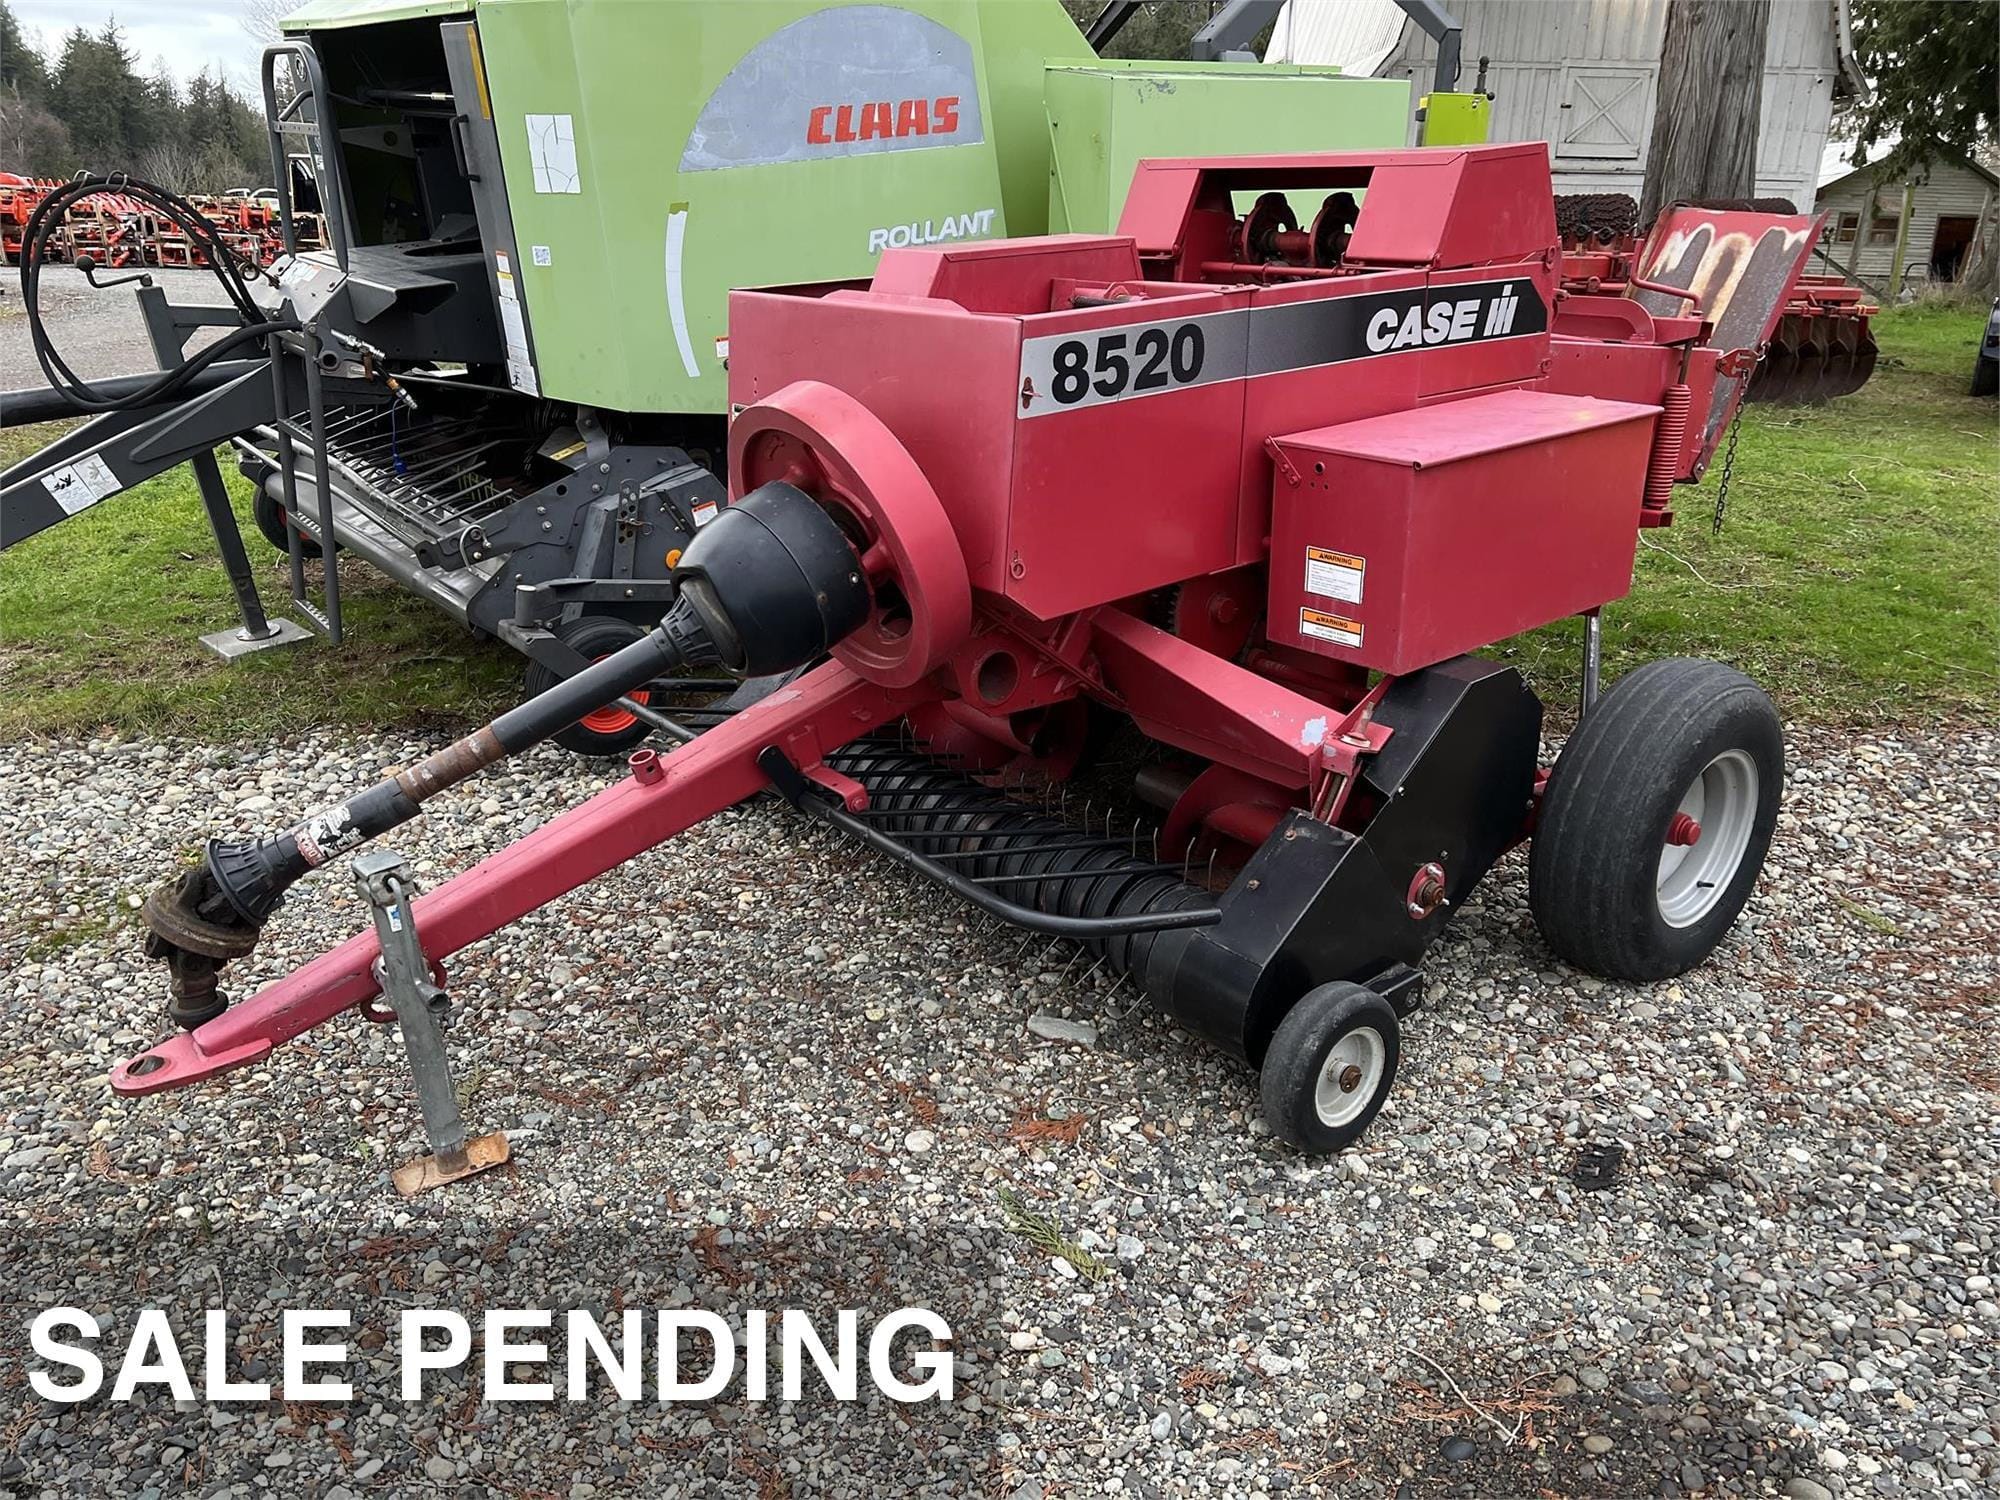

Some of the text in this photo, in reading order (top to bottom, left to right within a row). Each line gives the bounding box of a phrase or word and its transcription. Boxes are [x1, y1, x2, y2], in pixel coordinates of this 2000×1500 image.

[807, 96, 959, 144] CLAAS
[868, 209, 995, 253] ROLLANT
[1366, 301, 1481, 352] CASE
[1051, 323, 1205, 404] 8520
[1322, 552, 1352, 565] WARNING
[1319, 616, 1348, 628] WARNING
